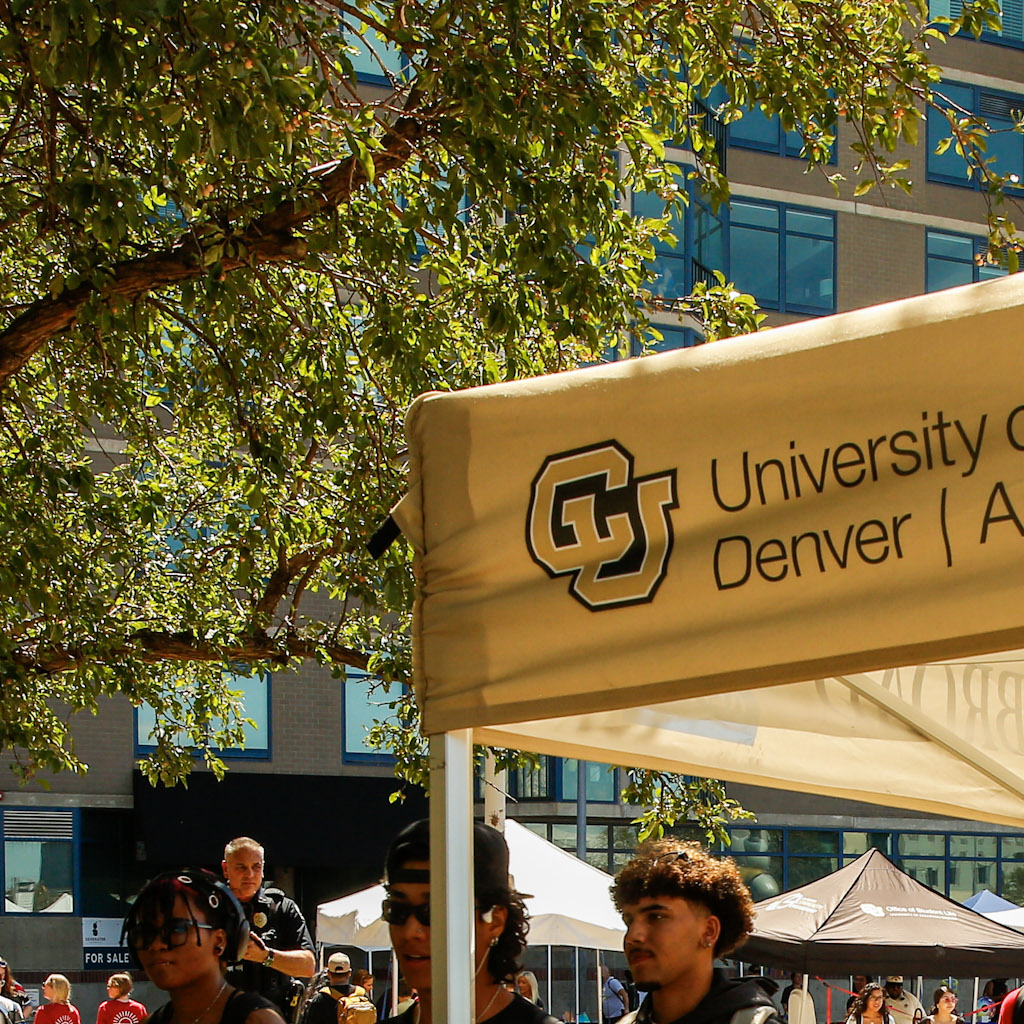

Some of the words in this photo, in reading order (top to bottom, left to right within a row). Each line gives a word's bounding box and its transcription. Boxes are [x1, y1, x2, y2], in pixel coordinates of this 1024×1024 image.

[710, 410, 988, 513] University
[525, 438, 679, 613] CU
[713, 511, 912, 591] Denver
[85, 953, 104, 963] FOR
[106, 953, 130, 963] SALE
